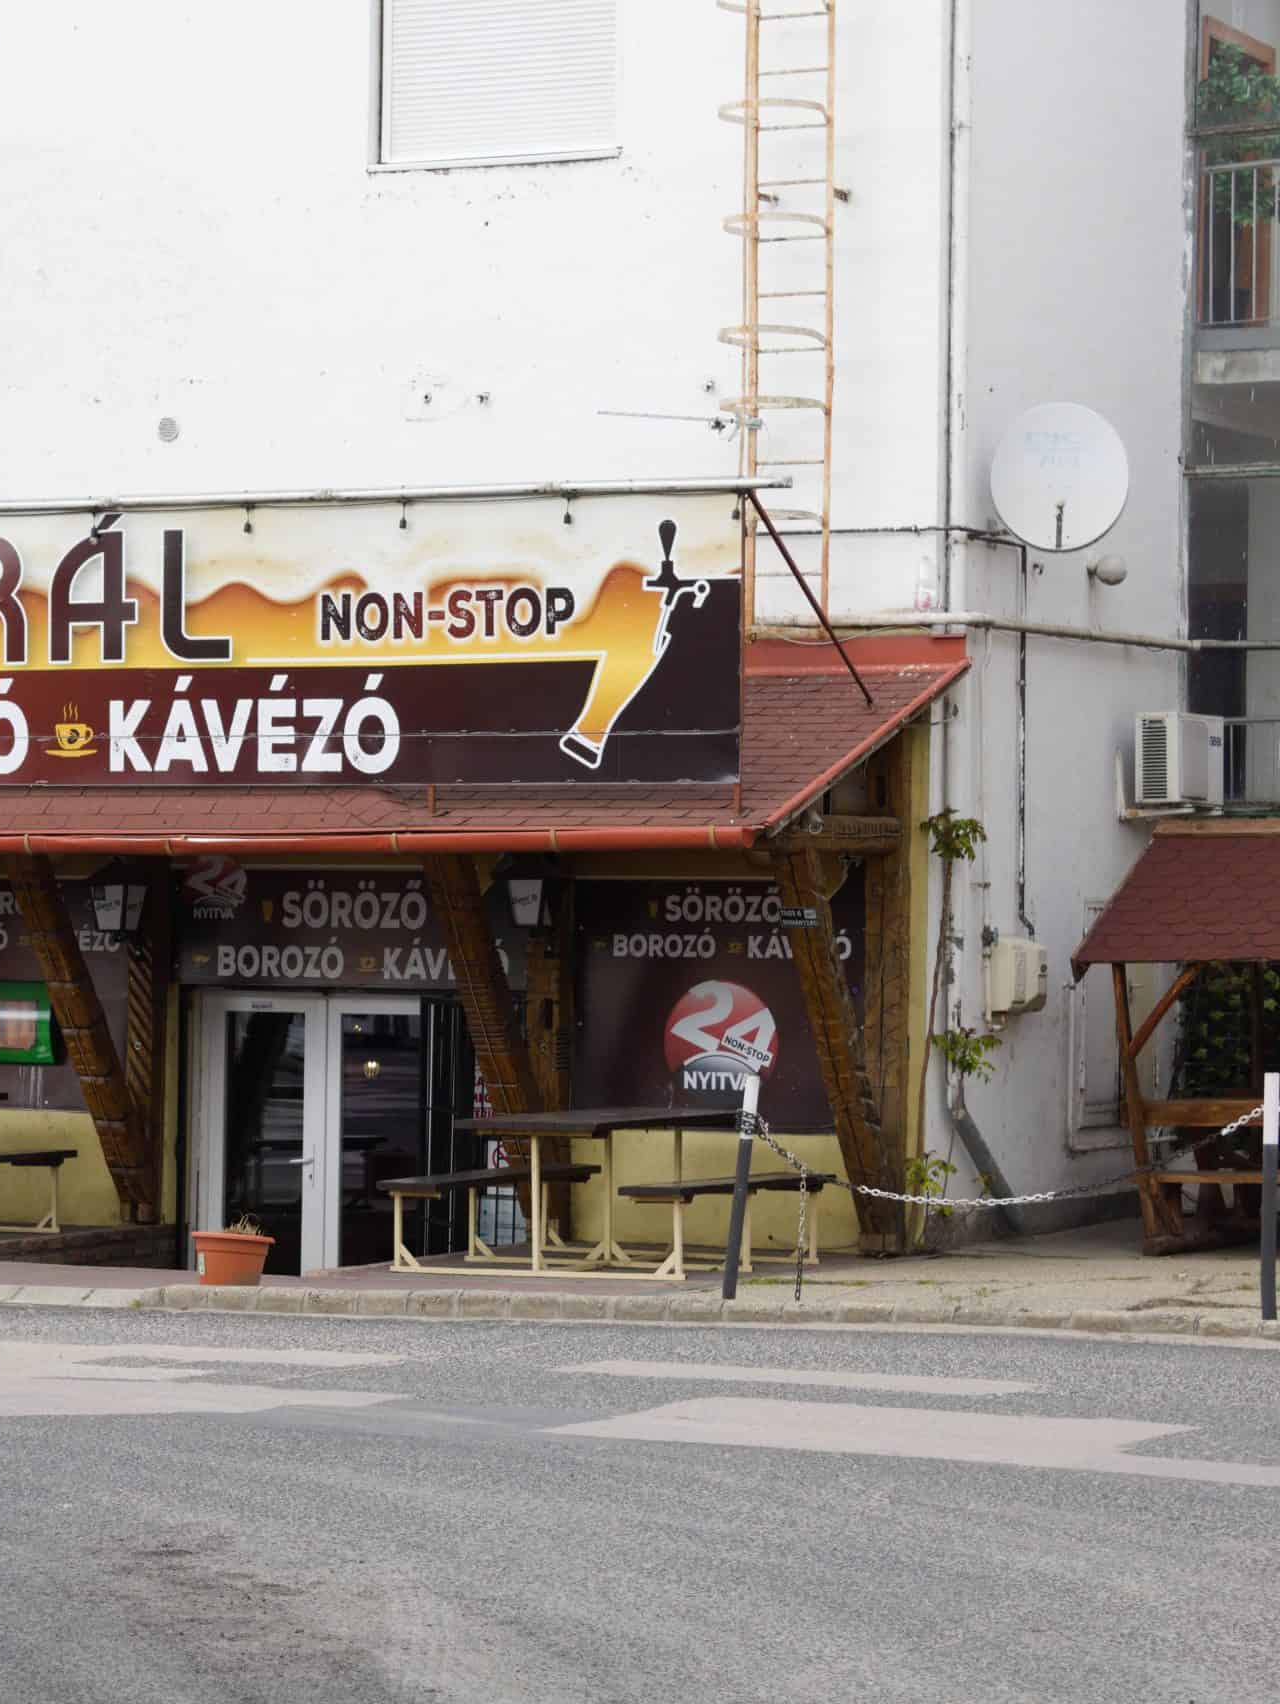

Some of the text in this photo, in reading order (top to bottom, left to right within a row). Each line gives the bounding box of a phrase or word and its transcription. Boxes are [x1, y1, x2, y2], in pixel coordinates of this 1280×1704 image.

[320, 587, 576, 641] NON-STOP
[109, 674, 400, 775] KÁVÉZÓ
[193, 906, 235, 920] NYITVA
[281, 879, 427, 930] SÖRÖZŐ
[216, 937, 344, 979] BOROZÓ
[612, 929, 716, 958] BOROZÓ
[671, 980, 776, 1072] 24
[724, 1035, 770, 1063] NON-STOP
